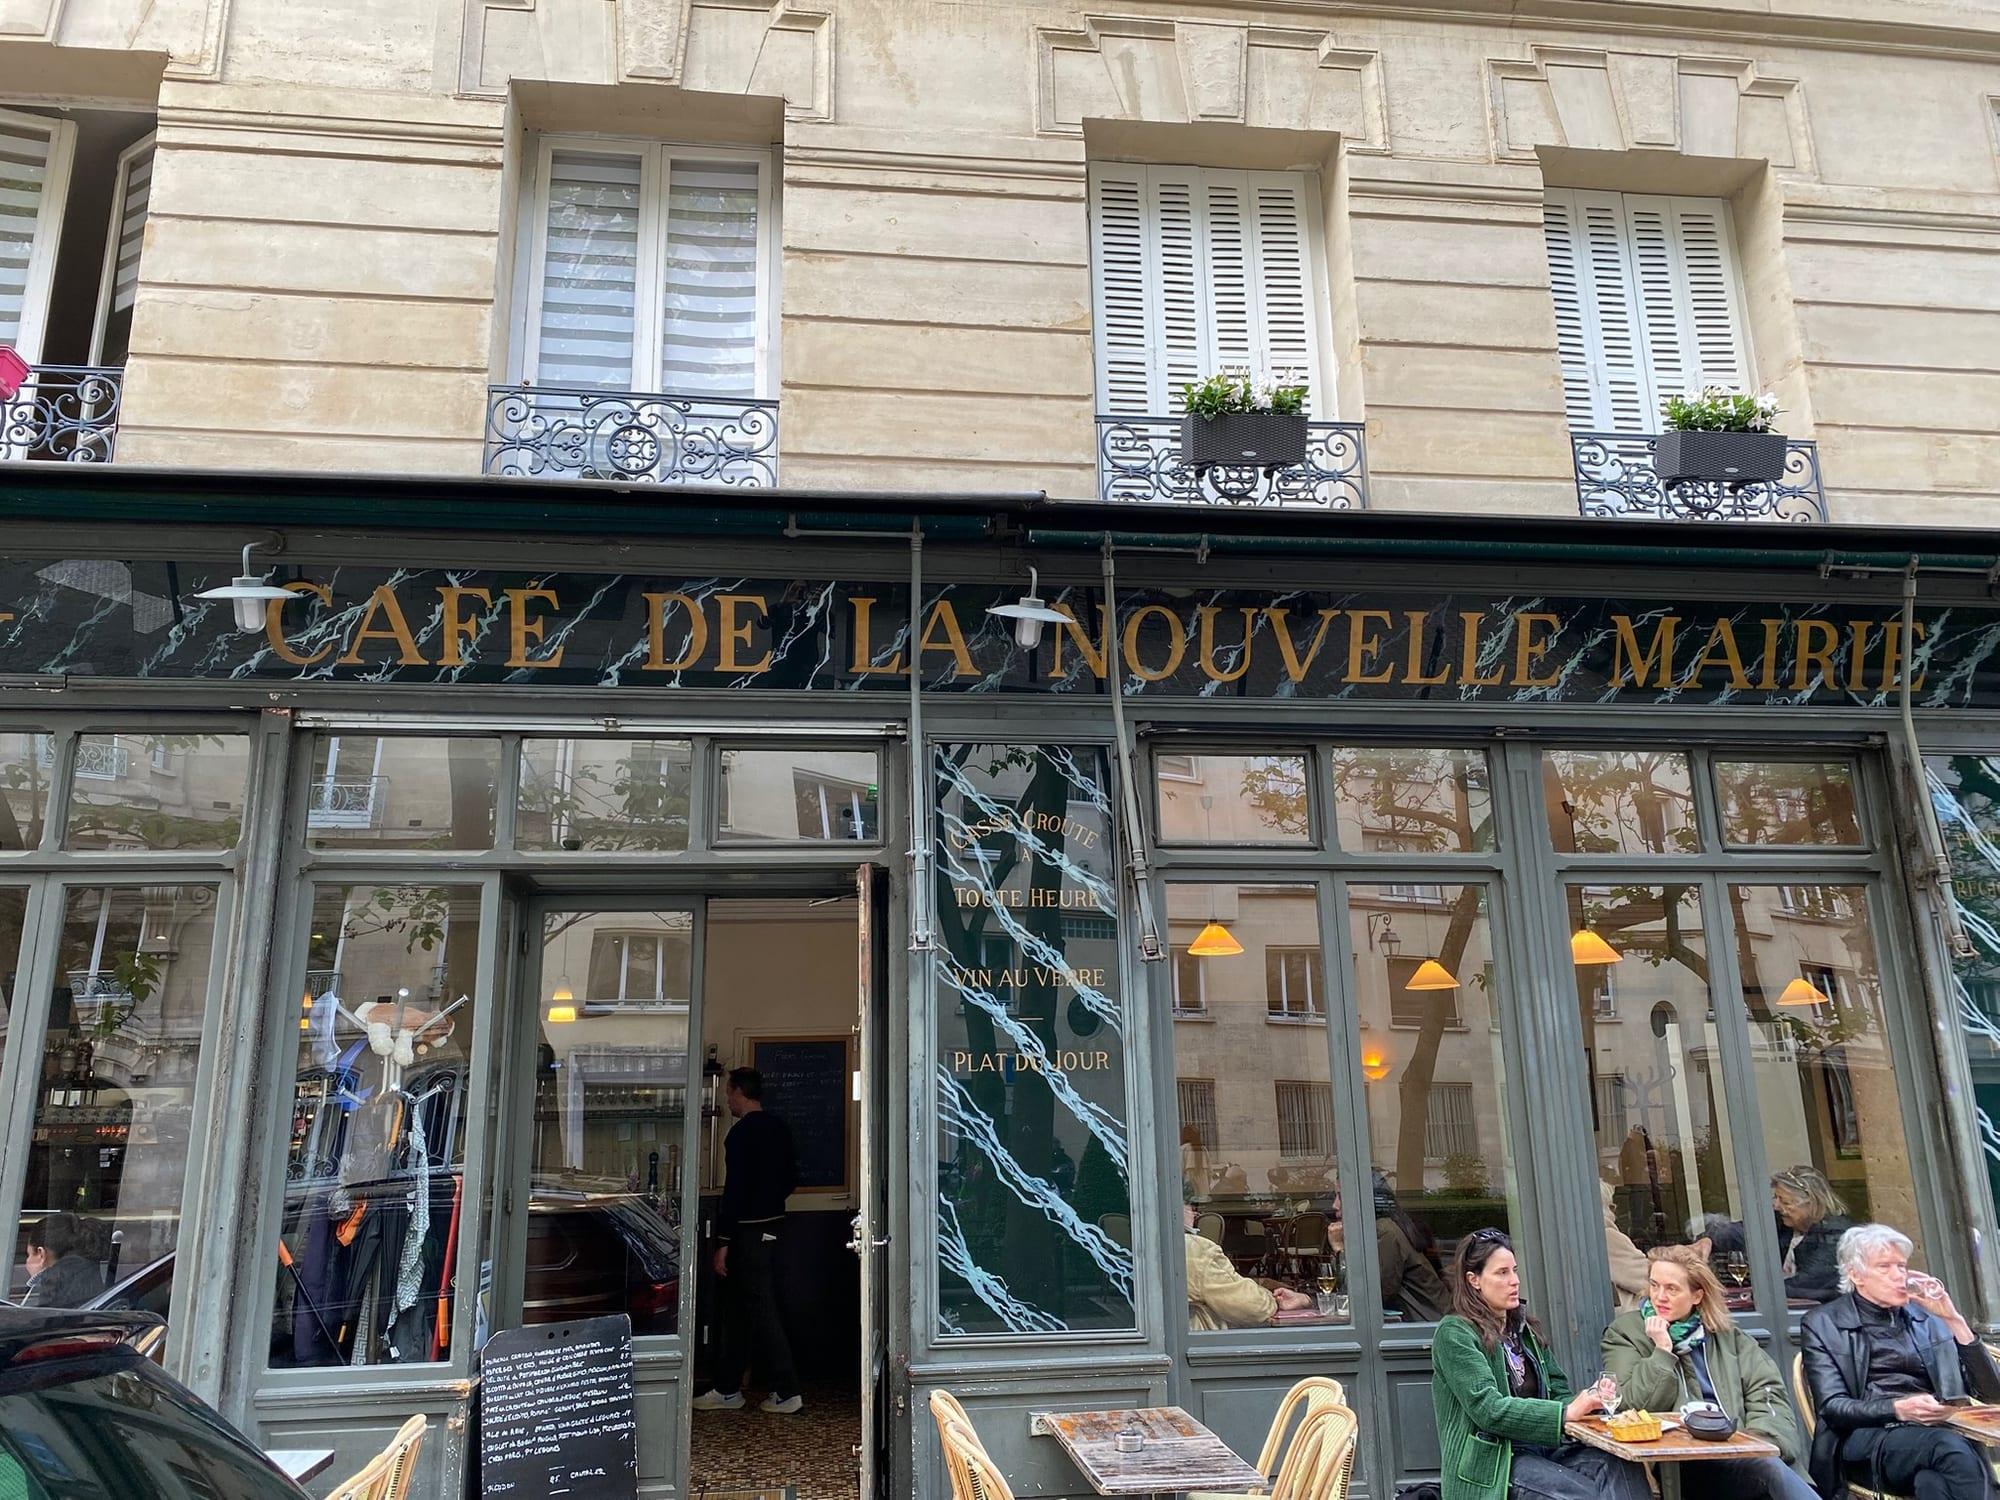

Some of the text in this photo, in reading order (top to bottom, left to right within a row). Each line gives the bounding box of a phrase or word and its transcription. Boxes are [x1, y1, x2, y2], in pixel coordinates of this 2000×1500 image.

[265, 580, 1927, 692] CAFÉ DE LA NOUVELLE MAIRIE
[954, 887, 1100, 908] TOUTE HEURE
[953, 967, 1105, 988] VIN AU VERRE
[954, 1049, 1109, 1072] PLAT DU JOUR
